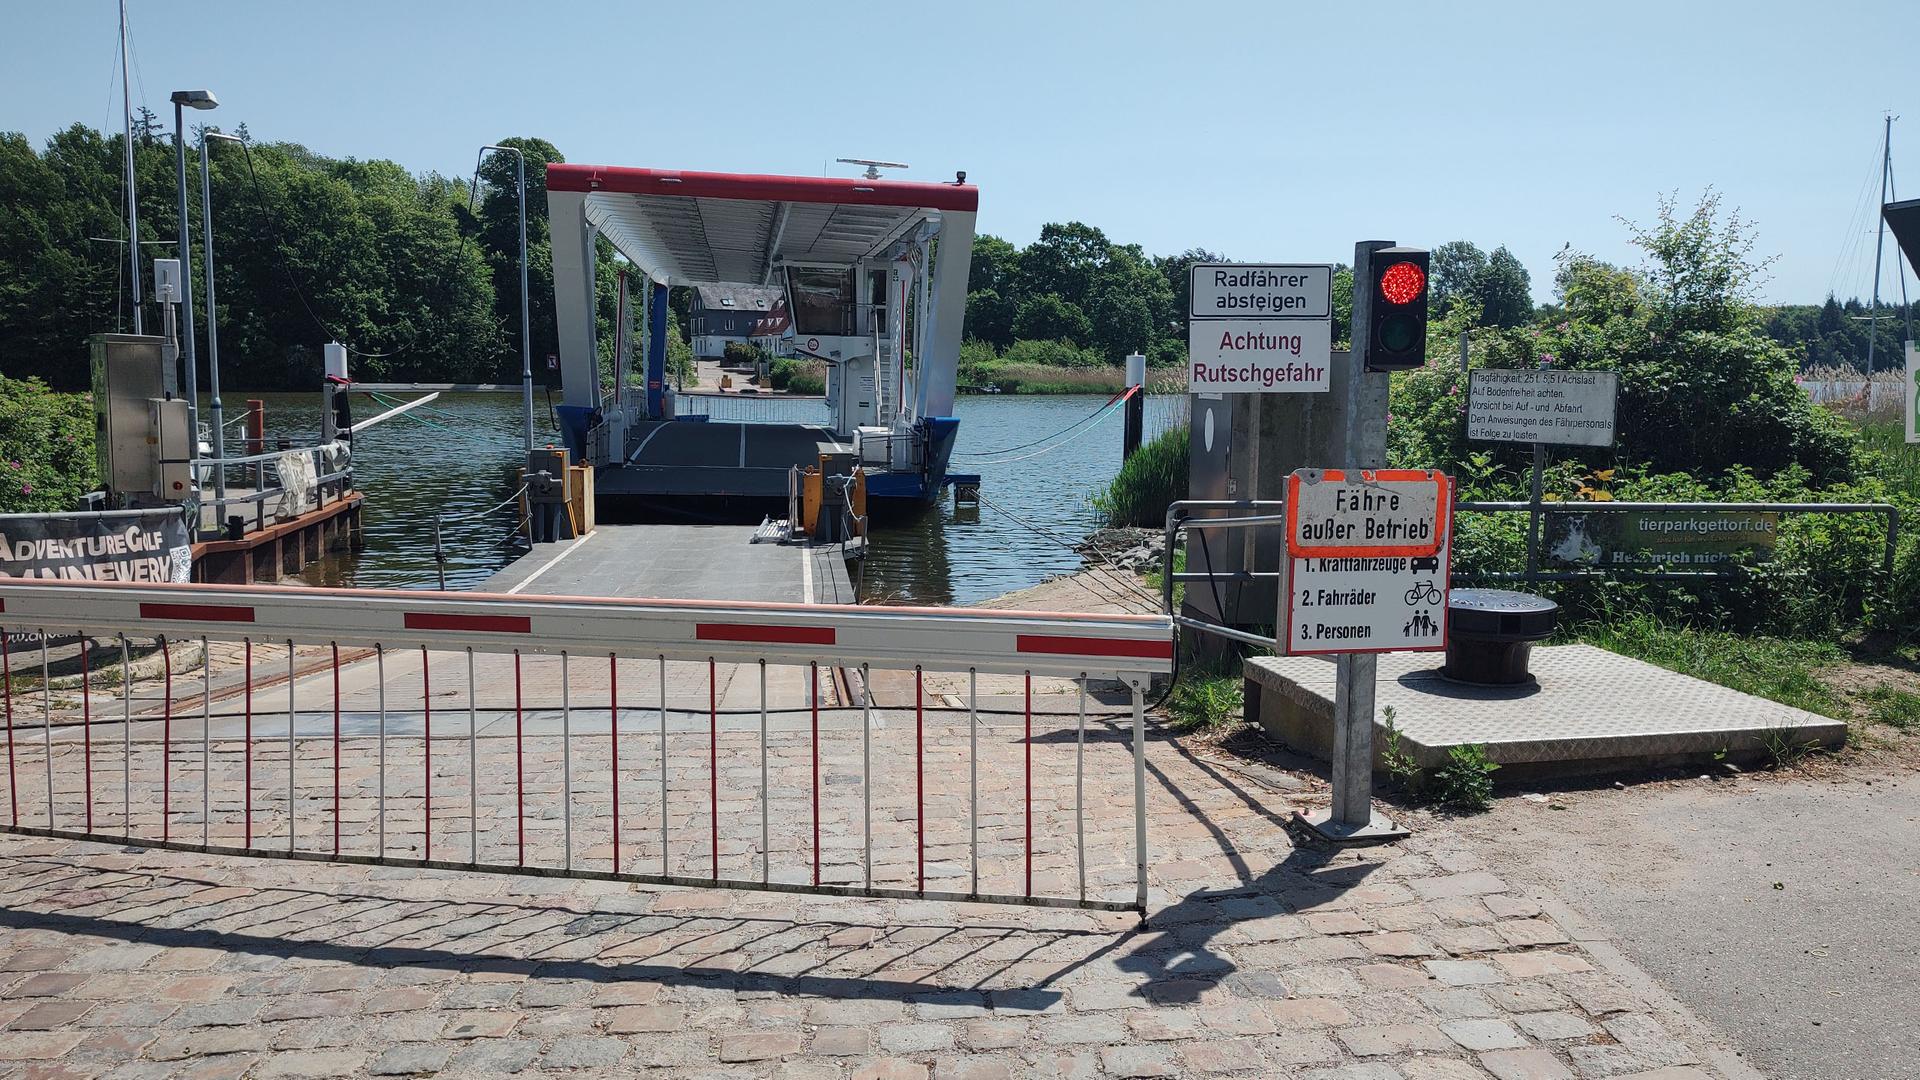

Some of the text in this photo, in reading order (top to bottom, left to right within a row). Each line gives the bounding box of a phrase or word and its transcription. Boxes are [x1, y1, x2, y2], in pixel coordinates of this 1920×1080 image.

[1214, 270, 1308, 287] Radfährer
[1216, 292, 1306, 312] absteigen
[1219, 331, 1302, 355] Achtung
[1193, 362, 1324, 387] Rutschgefahr
[1561, 375, 1596, 385] Achslast
[1472, 387, 1485, 396] Auf
[1486, 387, 1535, 398] Bodenfreiheit
[1472, 401, 1501, 410] Vorsicht
[1503, 402, 1514, 411] bei
[1535, 403, 1550, 412] und
[1554, 403, 1583, 414] Abfahrt
[1470, 414, 1613, 430] Den Anweisungen des Fährpersonals
[1469, 428, 1479, 437] ist
[1480, 428, 1501, 440] Folge
[1502, 431, 1512, 439] zu
[1336, 489, 1400, 512] Fähre
[1302, 517, 1429, 540] außer Betrieb
[1638, 517, 1773, 534] tierparkgettorf.de
[1305, 557, 1407, 574] 1. Kraftfahrzeuge
[1651, 551, 1690, 564] mich
[1694, 551, 1731, 564] nich
[1302, 588, 1376, 607] 2. Fahrräder
[1301, 623, 1371, 640] 3. Personen
